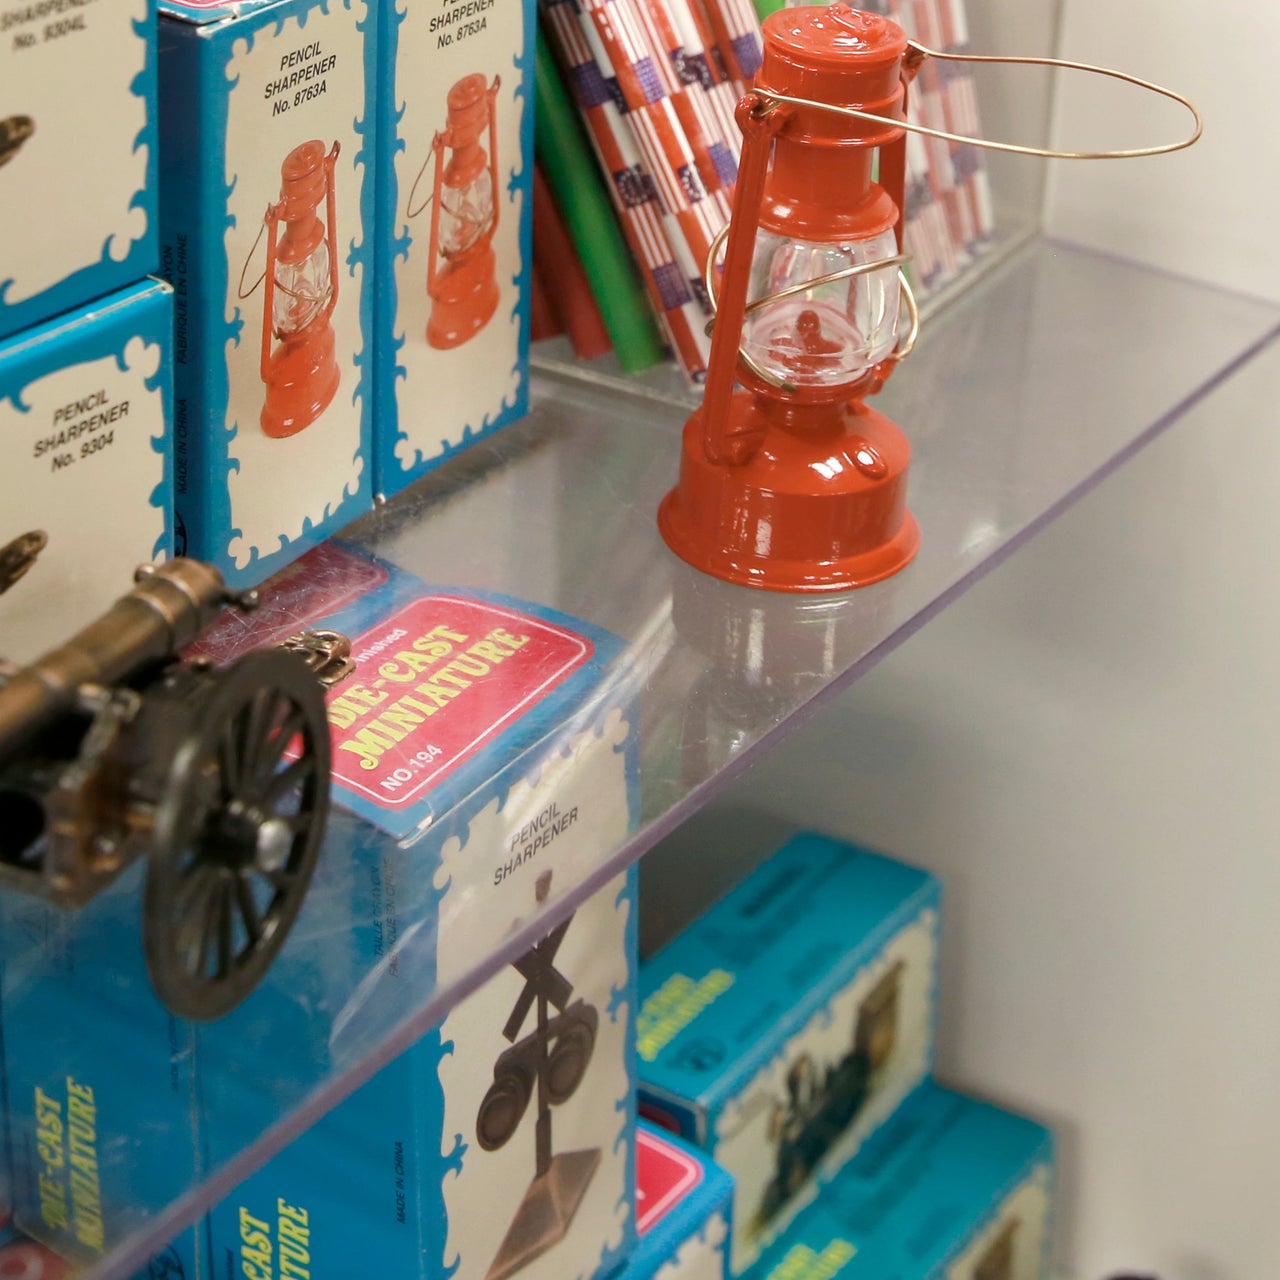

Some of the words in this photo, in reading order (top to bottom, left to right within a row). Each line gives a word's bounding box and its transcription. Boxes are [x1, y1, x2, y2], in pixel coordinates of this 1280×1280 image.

[437, 33, 454, 49] No.
[456, 17, 487, 40] 8763A
[280, 41, 322, 71] PENCIL
[264, 55, 336, 100] SHARPENER
[272, 98, 291, 116] No.
[294, 84, 327, 108] 8763A
[162, 245, 173, 282] AYON
[176, 234, 188, 274] CHINE
[177, 278, 188, 297] EN
[177, 299, 188, 364] FABRIQUE
[53, 389, 109, 427] PENCIL
[177, 400, 188, 438] CHINA
[33, 401, 130, 458] SHARPENER
[177, 441, 188, 454] IN
[52, 453, 76, 472] No.
[80, 430, 115, 459] 9304
[177, 456, 188, 494] MADE
[358, 629, 407, 663] inished
[328, 625, 471, 729] DIE-CAST
[339, 627, 530, 770] MINIATURE
[381, 743, 442, 792] NO.194
[493, 806, 578, 886] SHARPENER
[510, 803, 561, 852] PENCIL
[34, 1086, 69, 1230] DIE-CAST
[66, 1075, 105, 1250] MINIATURE
[393, 1141, 405, 1176] CHINA
[396, 1191, 407, 1224] MADE
[239, 1206, 272, 1280] CAST
